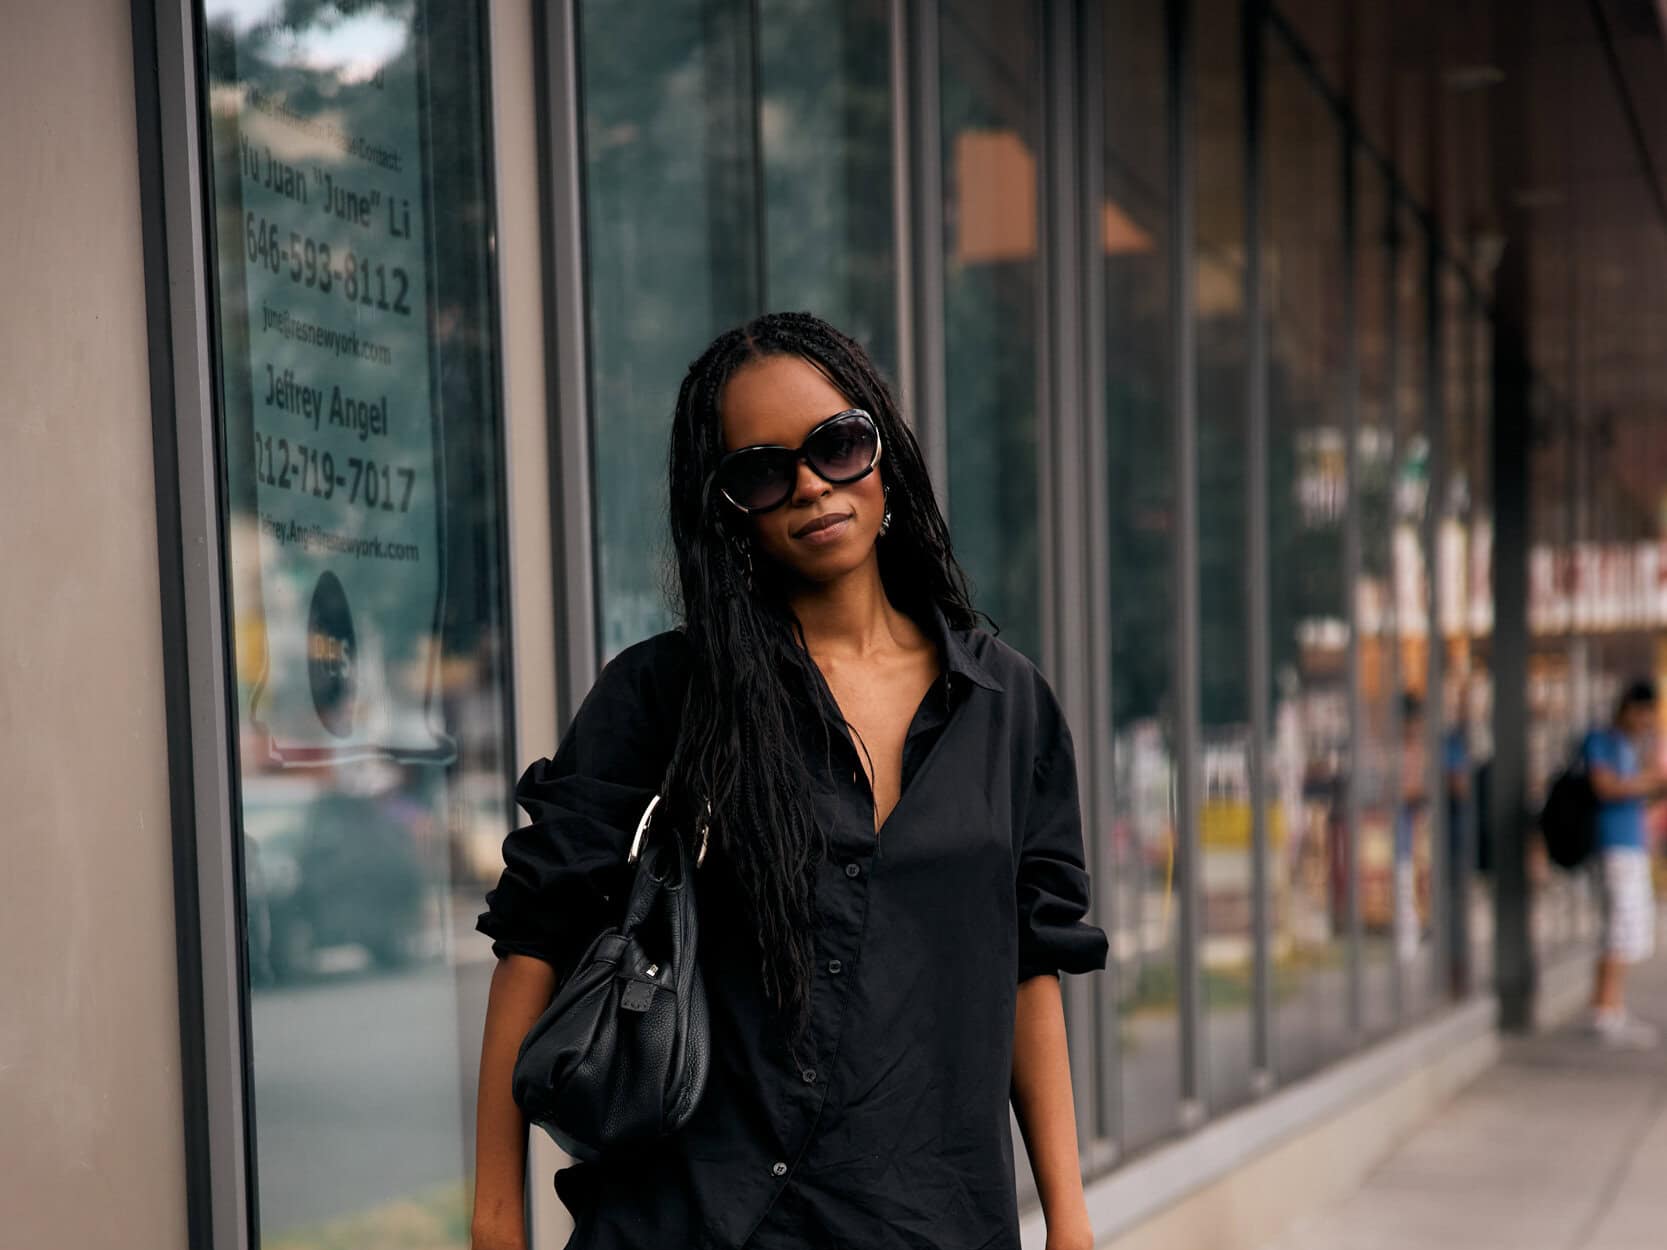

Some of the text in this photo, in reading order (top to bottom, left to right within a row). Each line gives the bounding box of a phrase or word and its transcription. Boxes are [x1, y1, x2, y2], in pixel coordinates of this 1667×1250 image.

[240, 131, 411, 240] Yu Juan "June" Li
[246, 210, 411, 317] 646-593-8112
[266, 364, 388, 443] Jeffrey Angel
[256, 431, 416, 513] 212-719-7017
